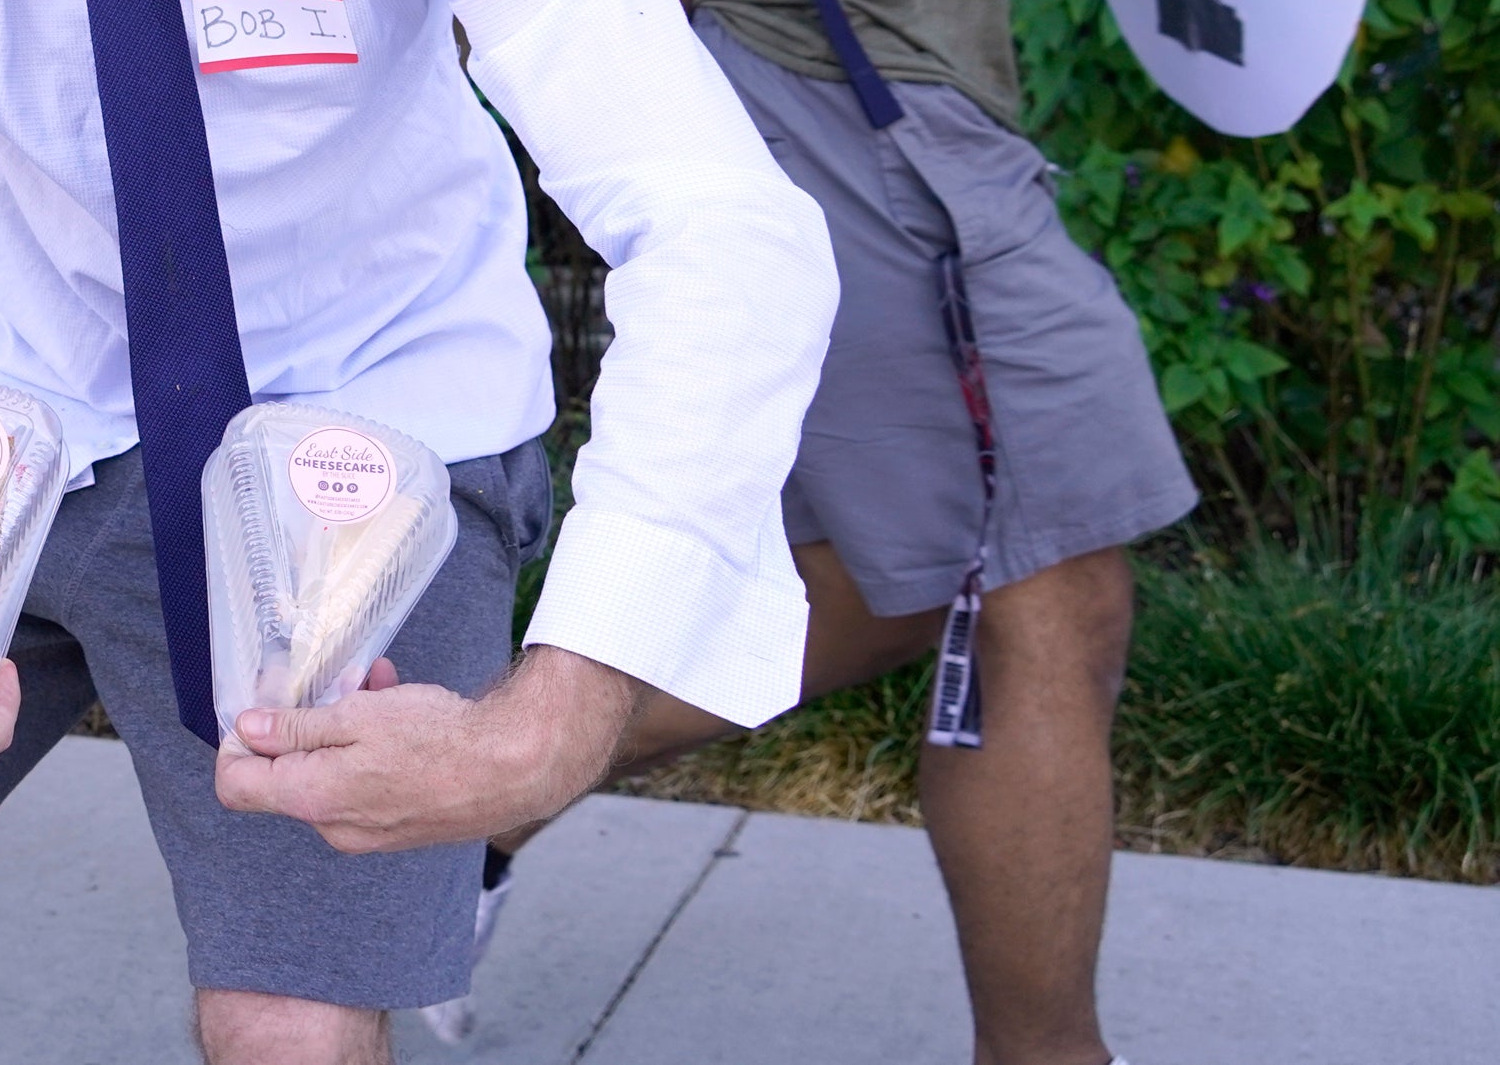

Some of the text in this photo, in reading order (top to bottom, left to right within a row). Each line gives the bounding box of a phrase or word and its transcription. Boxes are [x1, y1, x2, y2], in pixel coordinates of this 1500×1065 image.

[200, 5, 286, 49] BOB
[305, 443, 373, 462] East Side
[294, 457, 385, 474] CHEESECAKES
